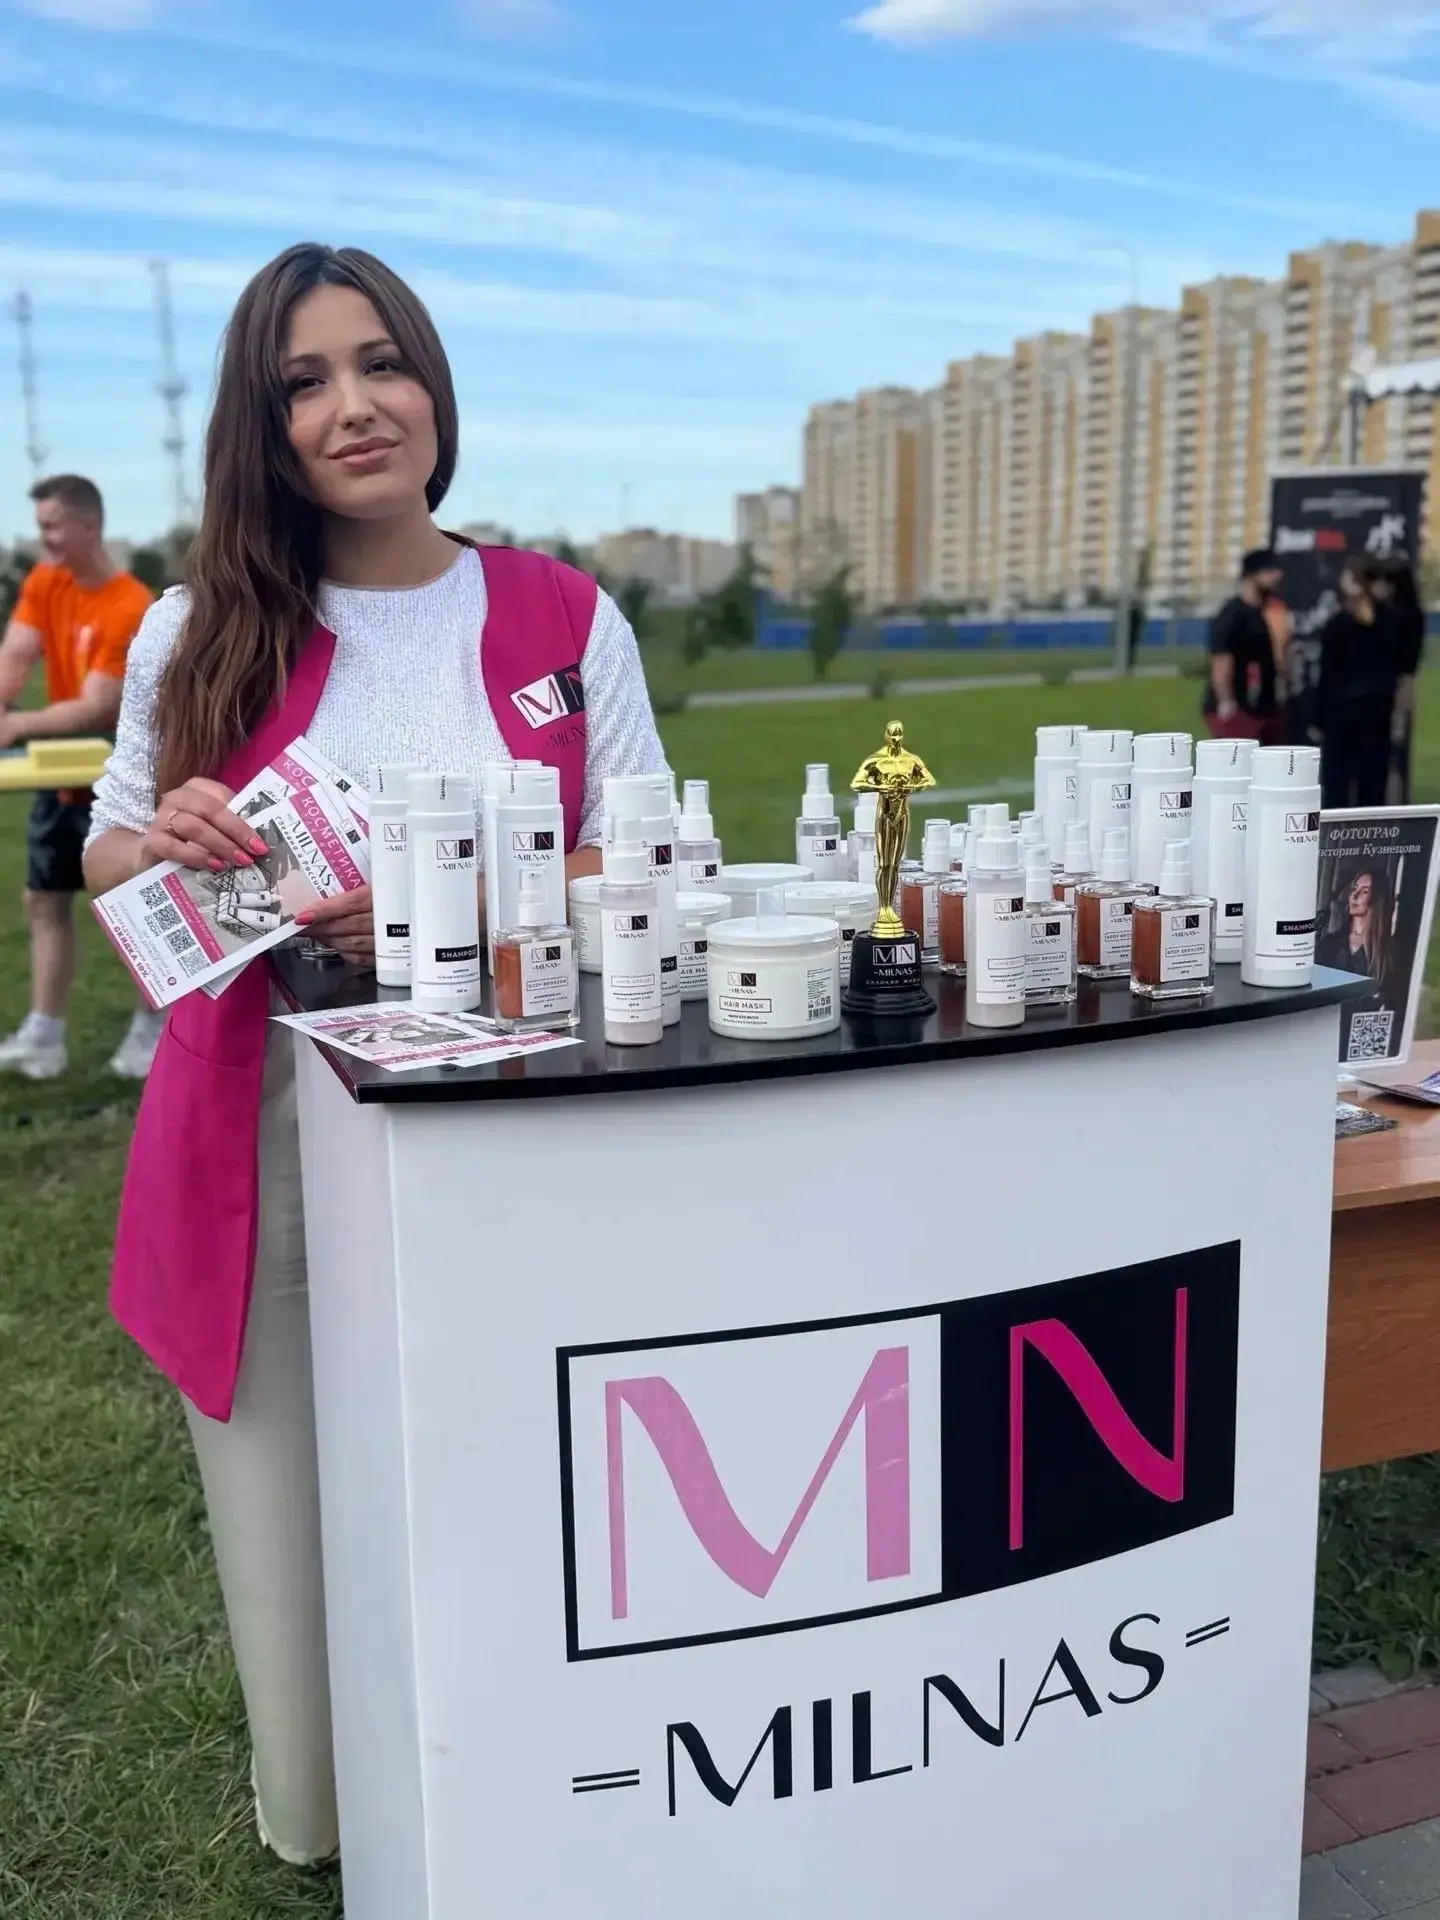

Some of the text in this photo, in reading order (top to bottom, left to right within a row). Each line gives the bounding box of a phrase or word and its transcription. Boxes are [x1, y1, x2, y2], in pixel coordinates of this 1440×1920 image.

[515, 833, 552, 849] MN
[1330, 826, 1399, 840] ФОТОГРАФ
[302, 797, 362, 888] КОСМЕТИКА
[1320, 843, 1421, 858] ктория Кузнецова
[289, 820, 333, 887] MILNAS
[114, 926, 138, 961] СКИДКА
[441, 948, 476, 958] SHAMPOO
[875, 945, 913, 963] MN
[878, 967, 913, 977] MILNAS
[723, 1000, 740, 1008] HAIR
[604, 1286, 1188, 1620] MN
[666, 1612, 1166, 1817] MILNAS
